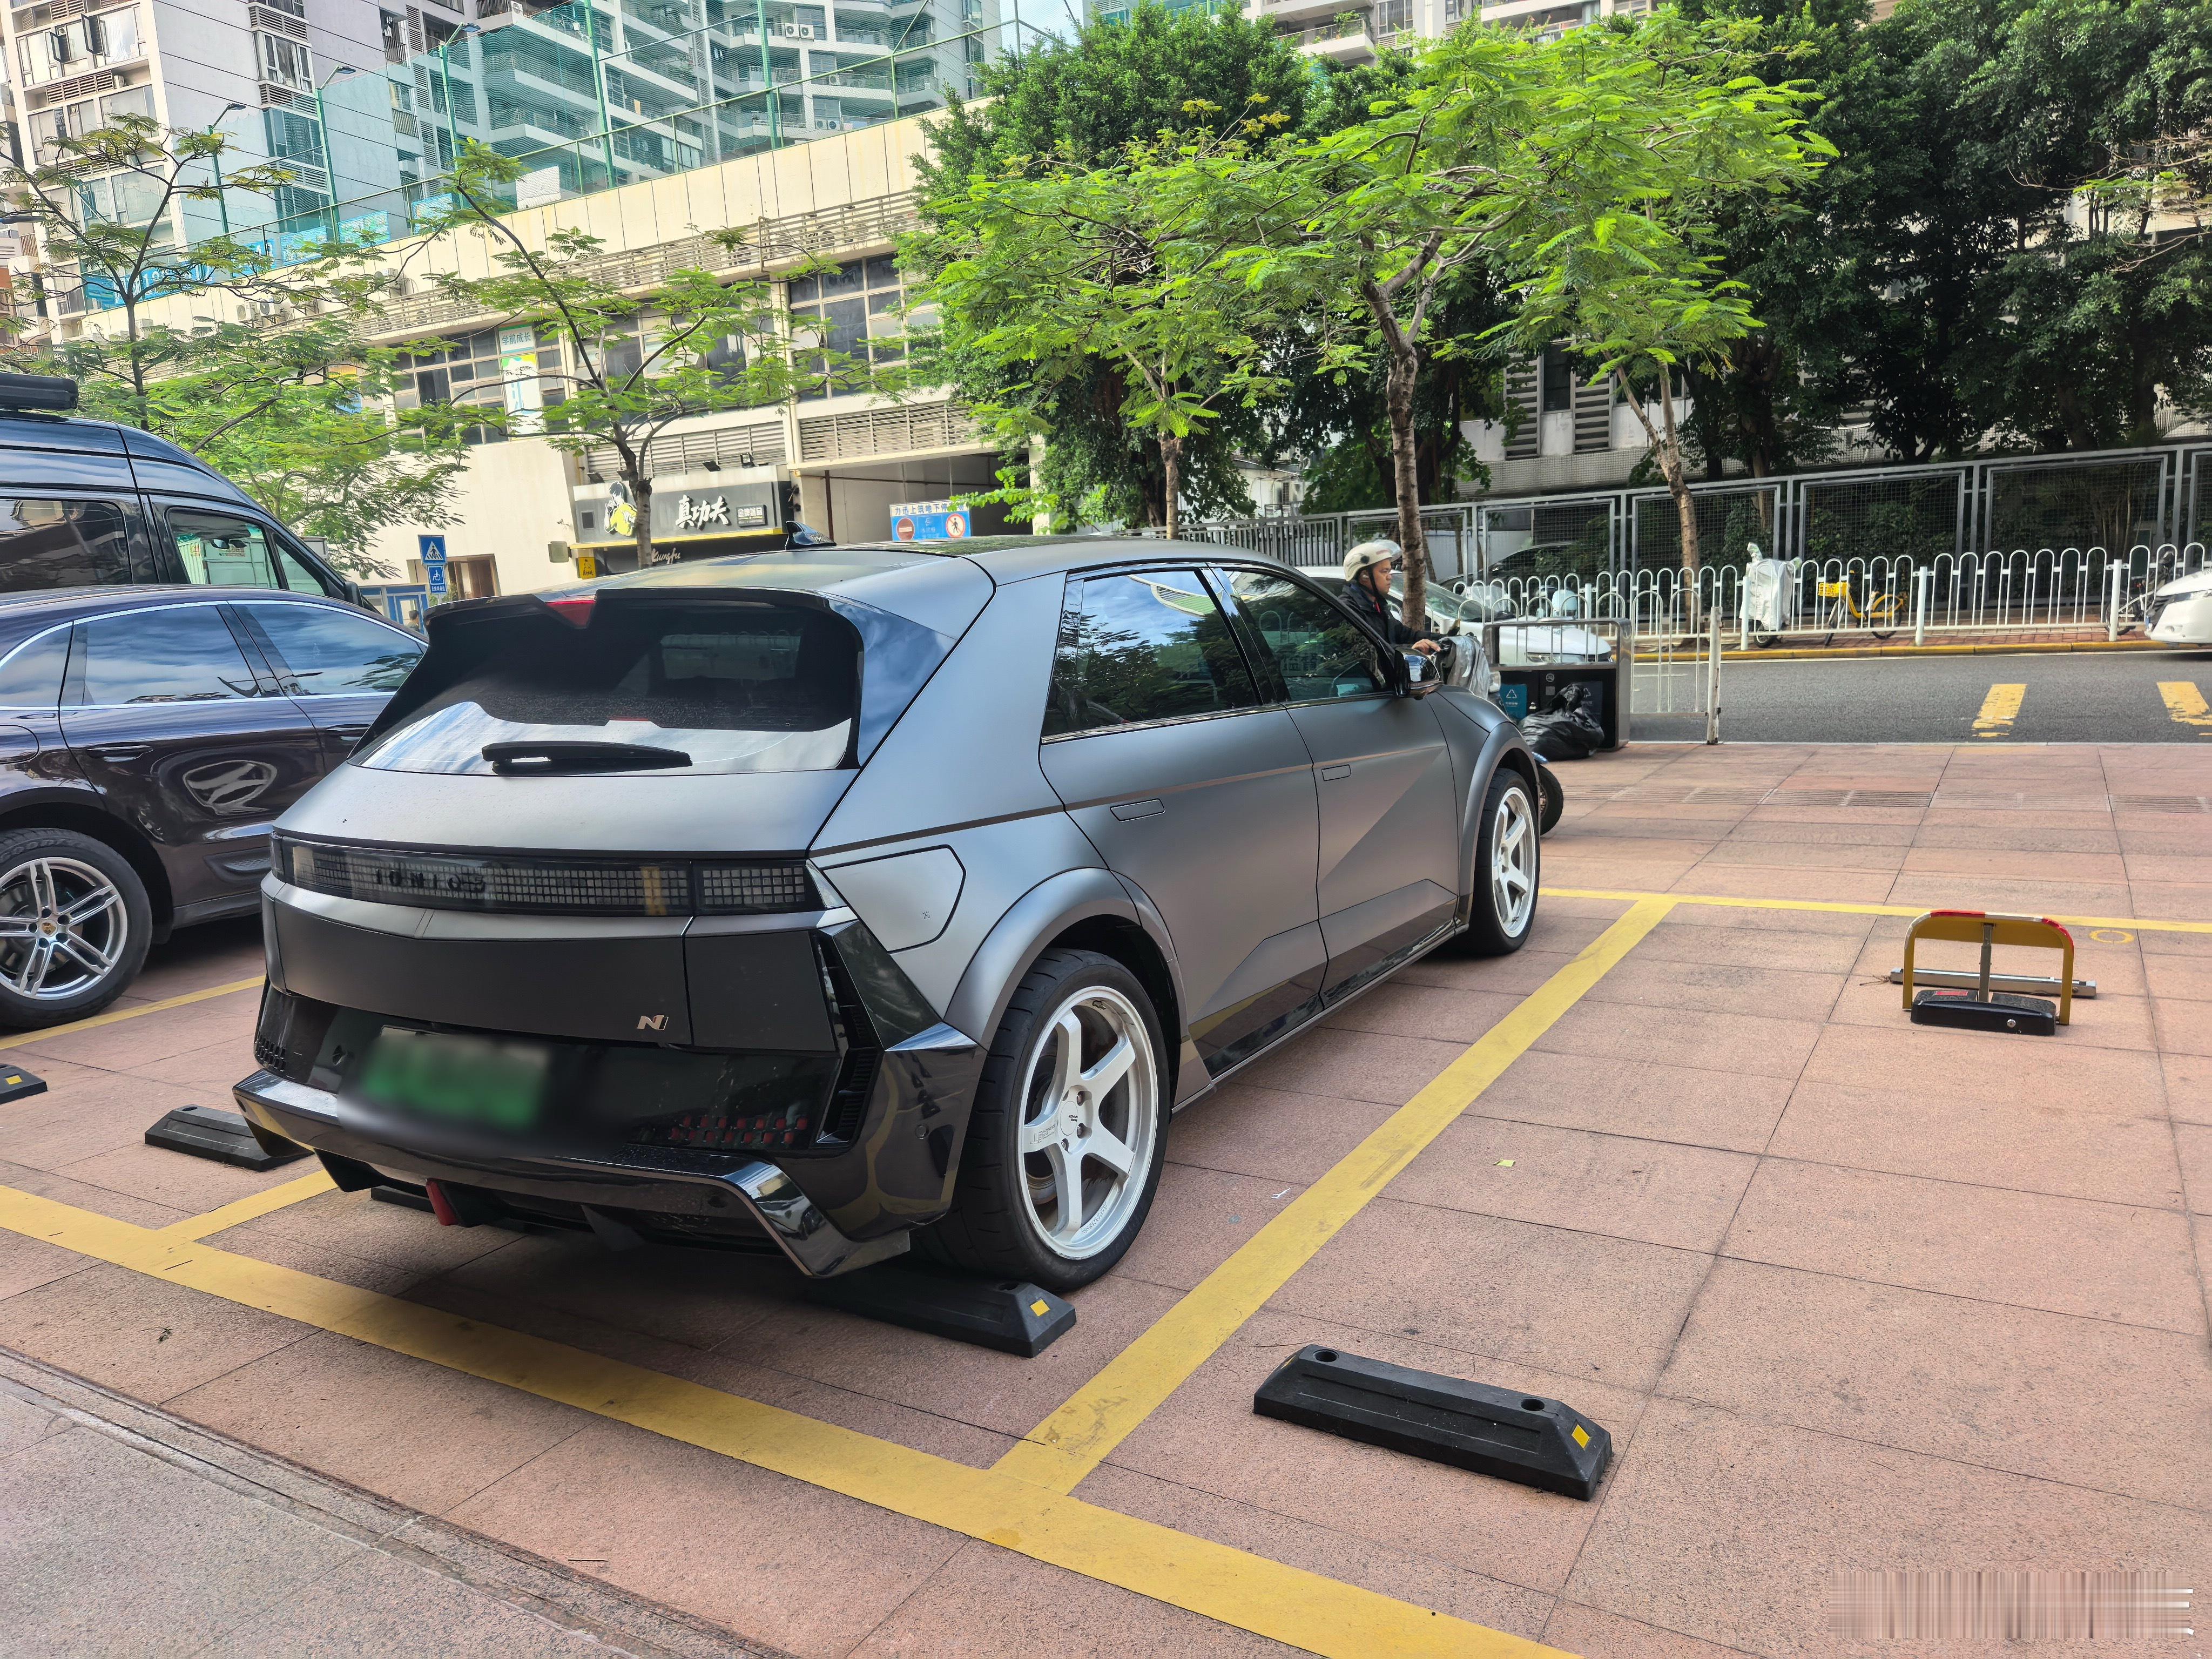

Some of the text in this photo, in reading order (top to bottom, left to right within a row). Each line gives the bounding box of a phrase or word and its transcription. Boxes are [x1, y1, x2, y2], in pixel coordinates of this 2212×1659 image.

[502, 332, 531, 345] 学前成长
[675, 494, 729, 529] 真功夫
[895, 502, 964, 515] 力迅上筑地下停场
